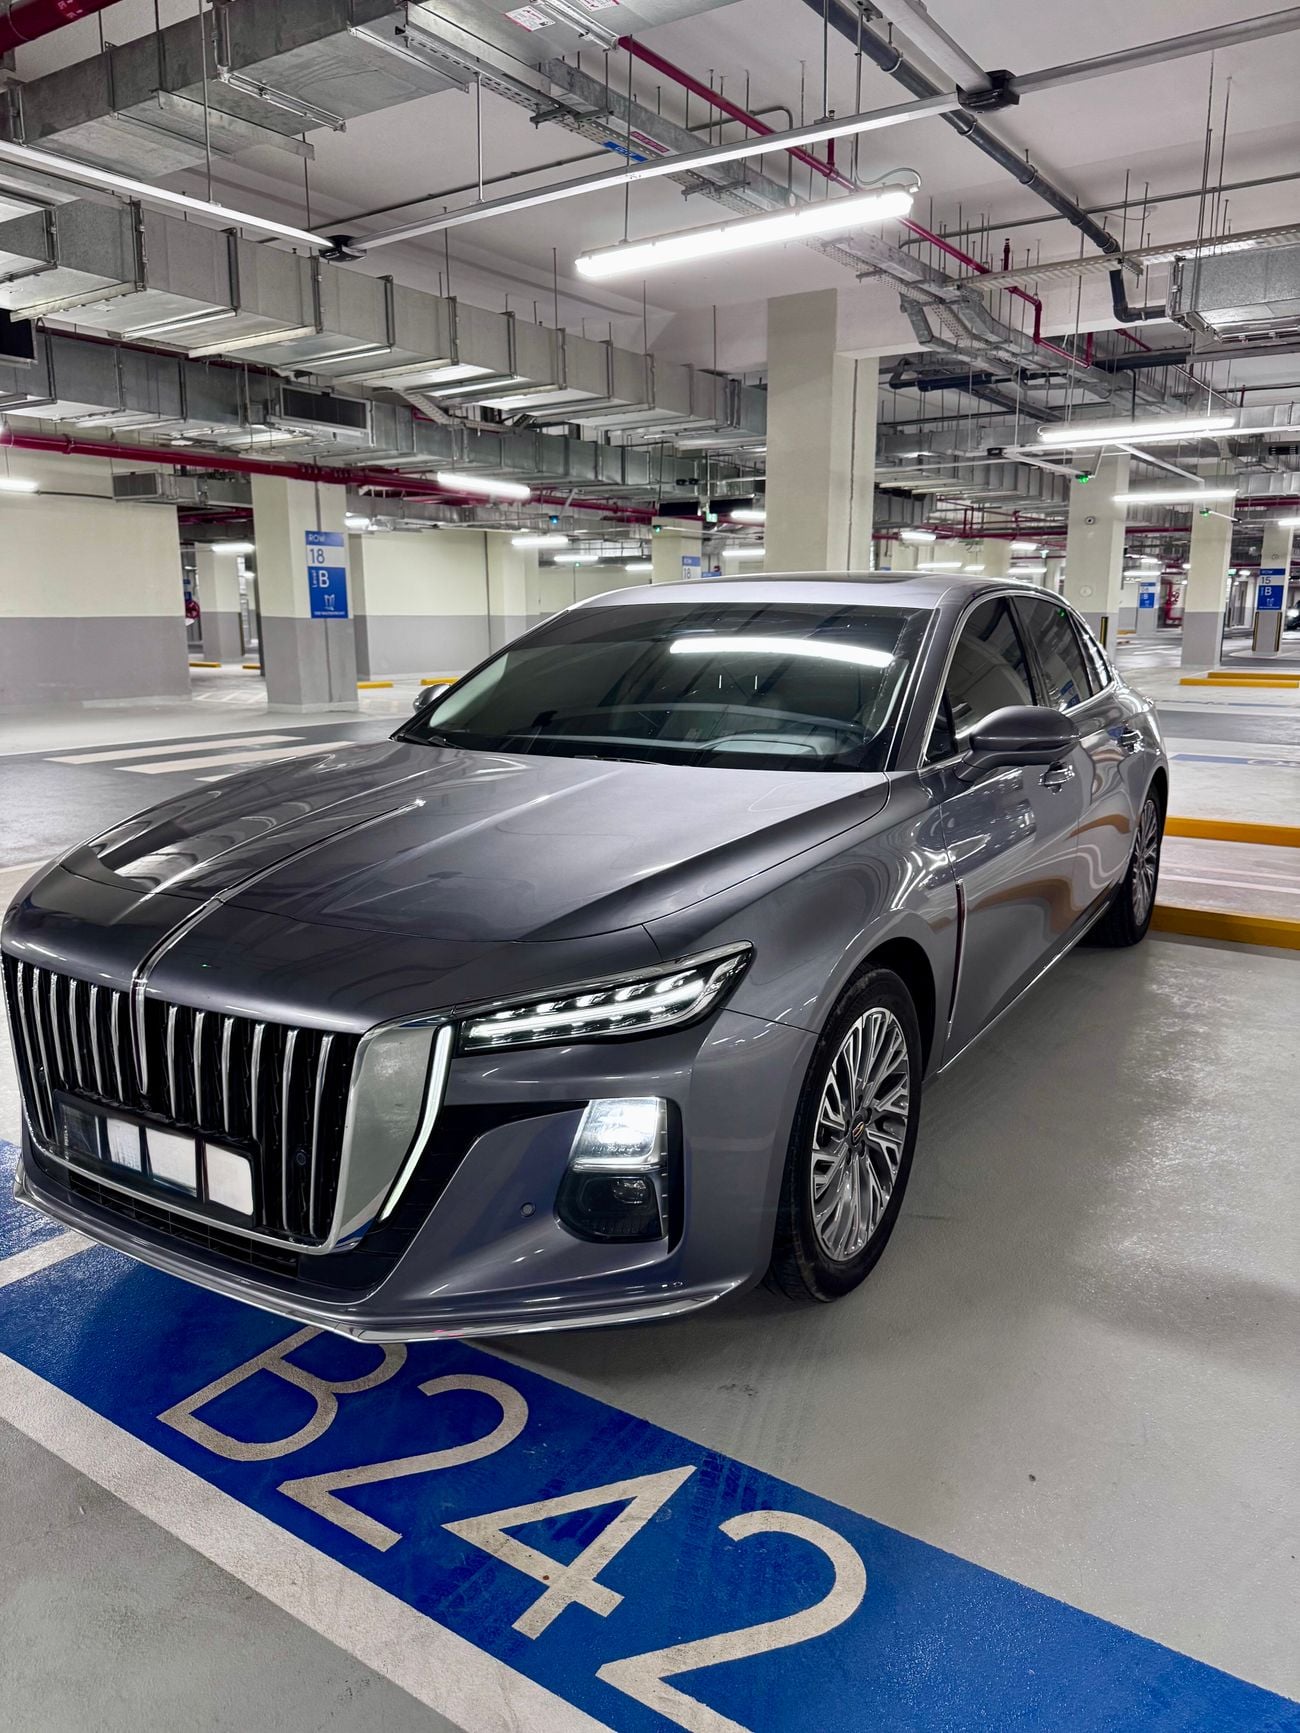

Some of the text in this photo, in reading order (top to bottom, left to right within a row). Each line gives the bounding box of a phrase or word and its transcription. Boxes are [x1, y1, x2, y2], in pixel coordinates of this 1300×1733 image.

[308, 533, 325, 542] ROW
[309, 548, 325, 564] 18
[319, 570, 329, 588] B
[1261, 576, 1271, 584] 15
[1264, 586, 1272, 596] B
[156, 1324, 867, 1733] B242
